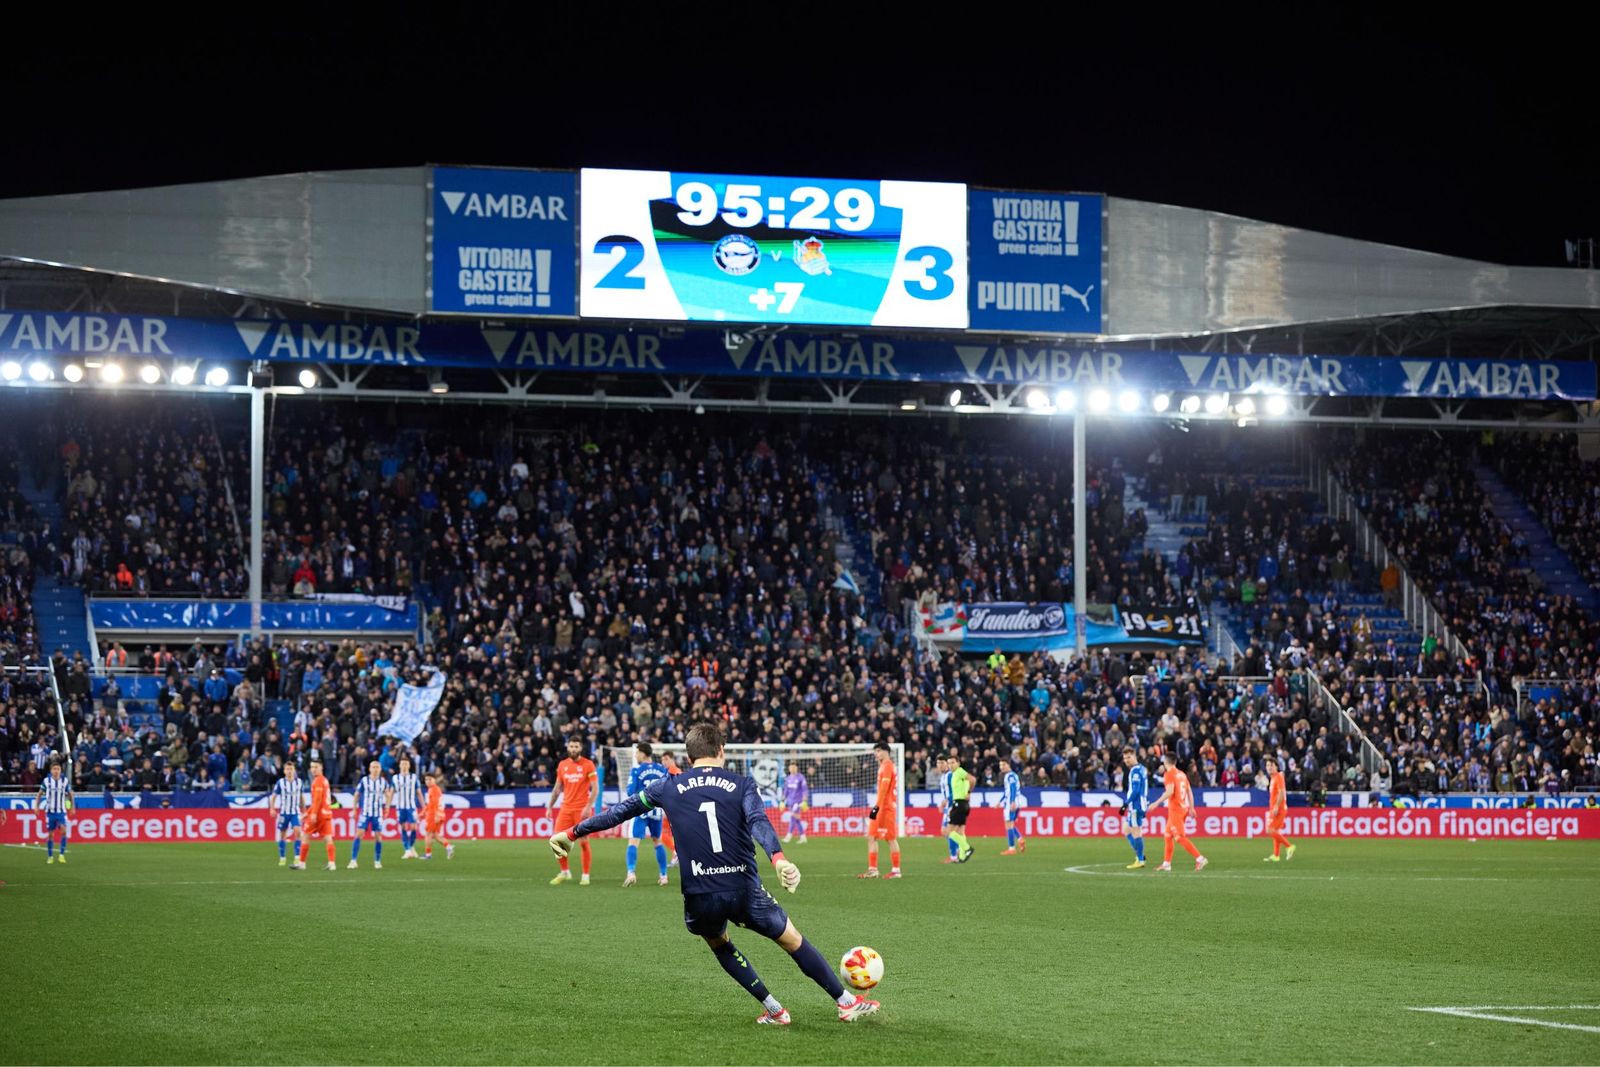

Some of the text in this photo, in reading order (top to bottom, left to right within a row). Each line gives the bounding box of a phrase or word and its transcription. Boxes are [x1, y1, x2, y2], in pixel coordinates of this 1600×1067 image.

[464, 193, 568, 222] AMBAR
[675, 181, 876, 232] 95:29
[992, 197, 1062, 221] VITORIA
[992, 220, 1062, 243] GASTEIZ
[458, 246, 533, 270] VITORIA
[592, 234, 646, 290] 2
[998, 243, 1062, 257] green capital
[458, 269, 533, 293] GASTEIZ
[903, 245, 955, 301] 3
[464, 293, 533, 308] green capital
[748, 281, 806, 315] +7
[978, 281, 1062, 312] PUMA
[12, 314, 172, 355] AMBAR
[270, 323, 425, 363] AMBAR
[515, 331, 666, 370] AMBAR
[755, 337, 900, 377] AMBAR
[986, 346, 1124, 386] AMBAR
[1210, 356, 1347, 393] AMBAR
[1431, 360, 1564, 397] AMBAR
[676, 776, 737, 794] A.REMIRO
[16, 814, 49, 839] Tu
[67, 813, 218, 839] referente
[226, 818, 265, 838] en
[698, 801, 723, 854] 1
[1020, 812, 1053, 835] Tu
[1204, 816, 1236, 835] en
[1439, 809, 1579, 836] financiera
[691, 860, 747, 876] Kutxabank
